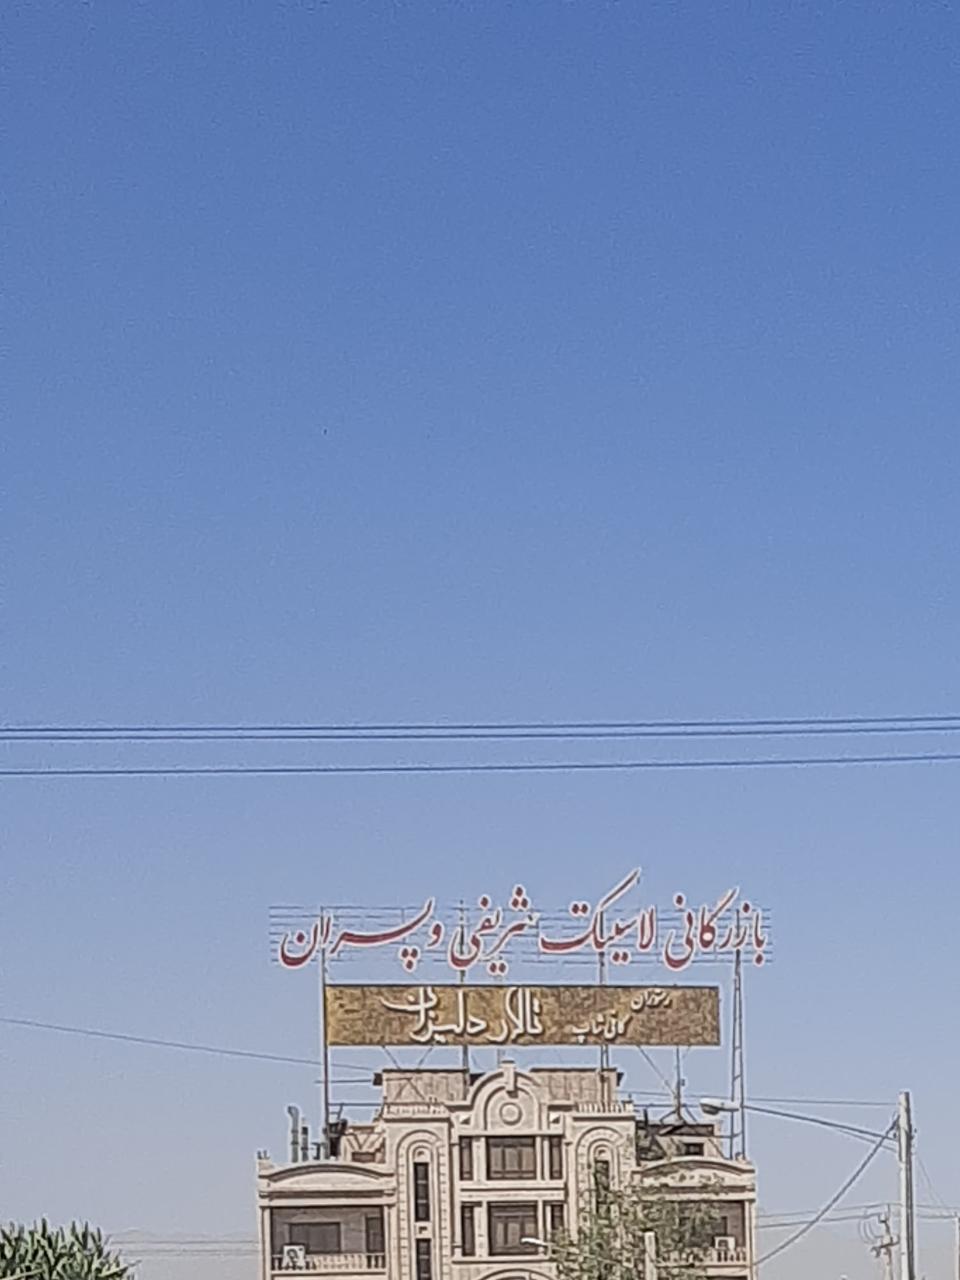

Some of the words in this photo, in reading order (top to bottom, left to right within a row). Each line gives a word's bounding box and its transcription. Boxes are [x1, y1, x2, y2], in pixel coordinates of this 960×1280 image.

[280, 896, 435, 970] پسران
[425, 922, 444, 948] و
[450, 885, 542, 973] شریفی
[664, 887, 767, 970] بازرگانی
[486, 987, 543, 1042] تالار
